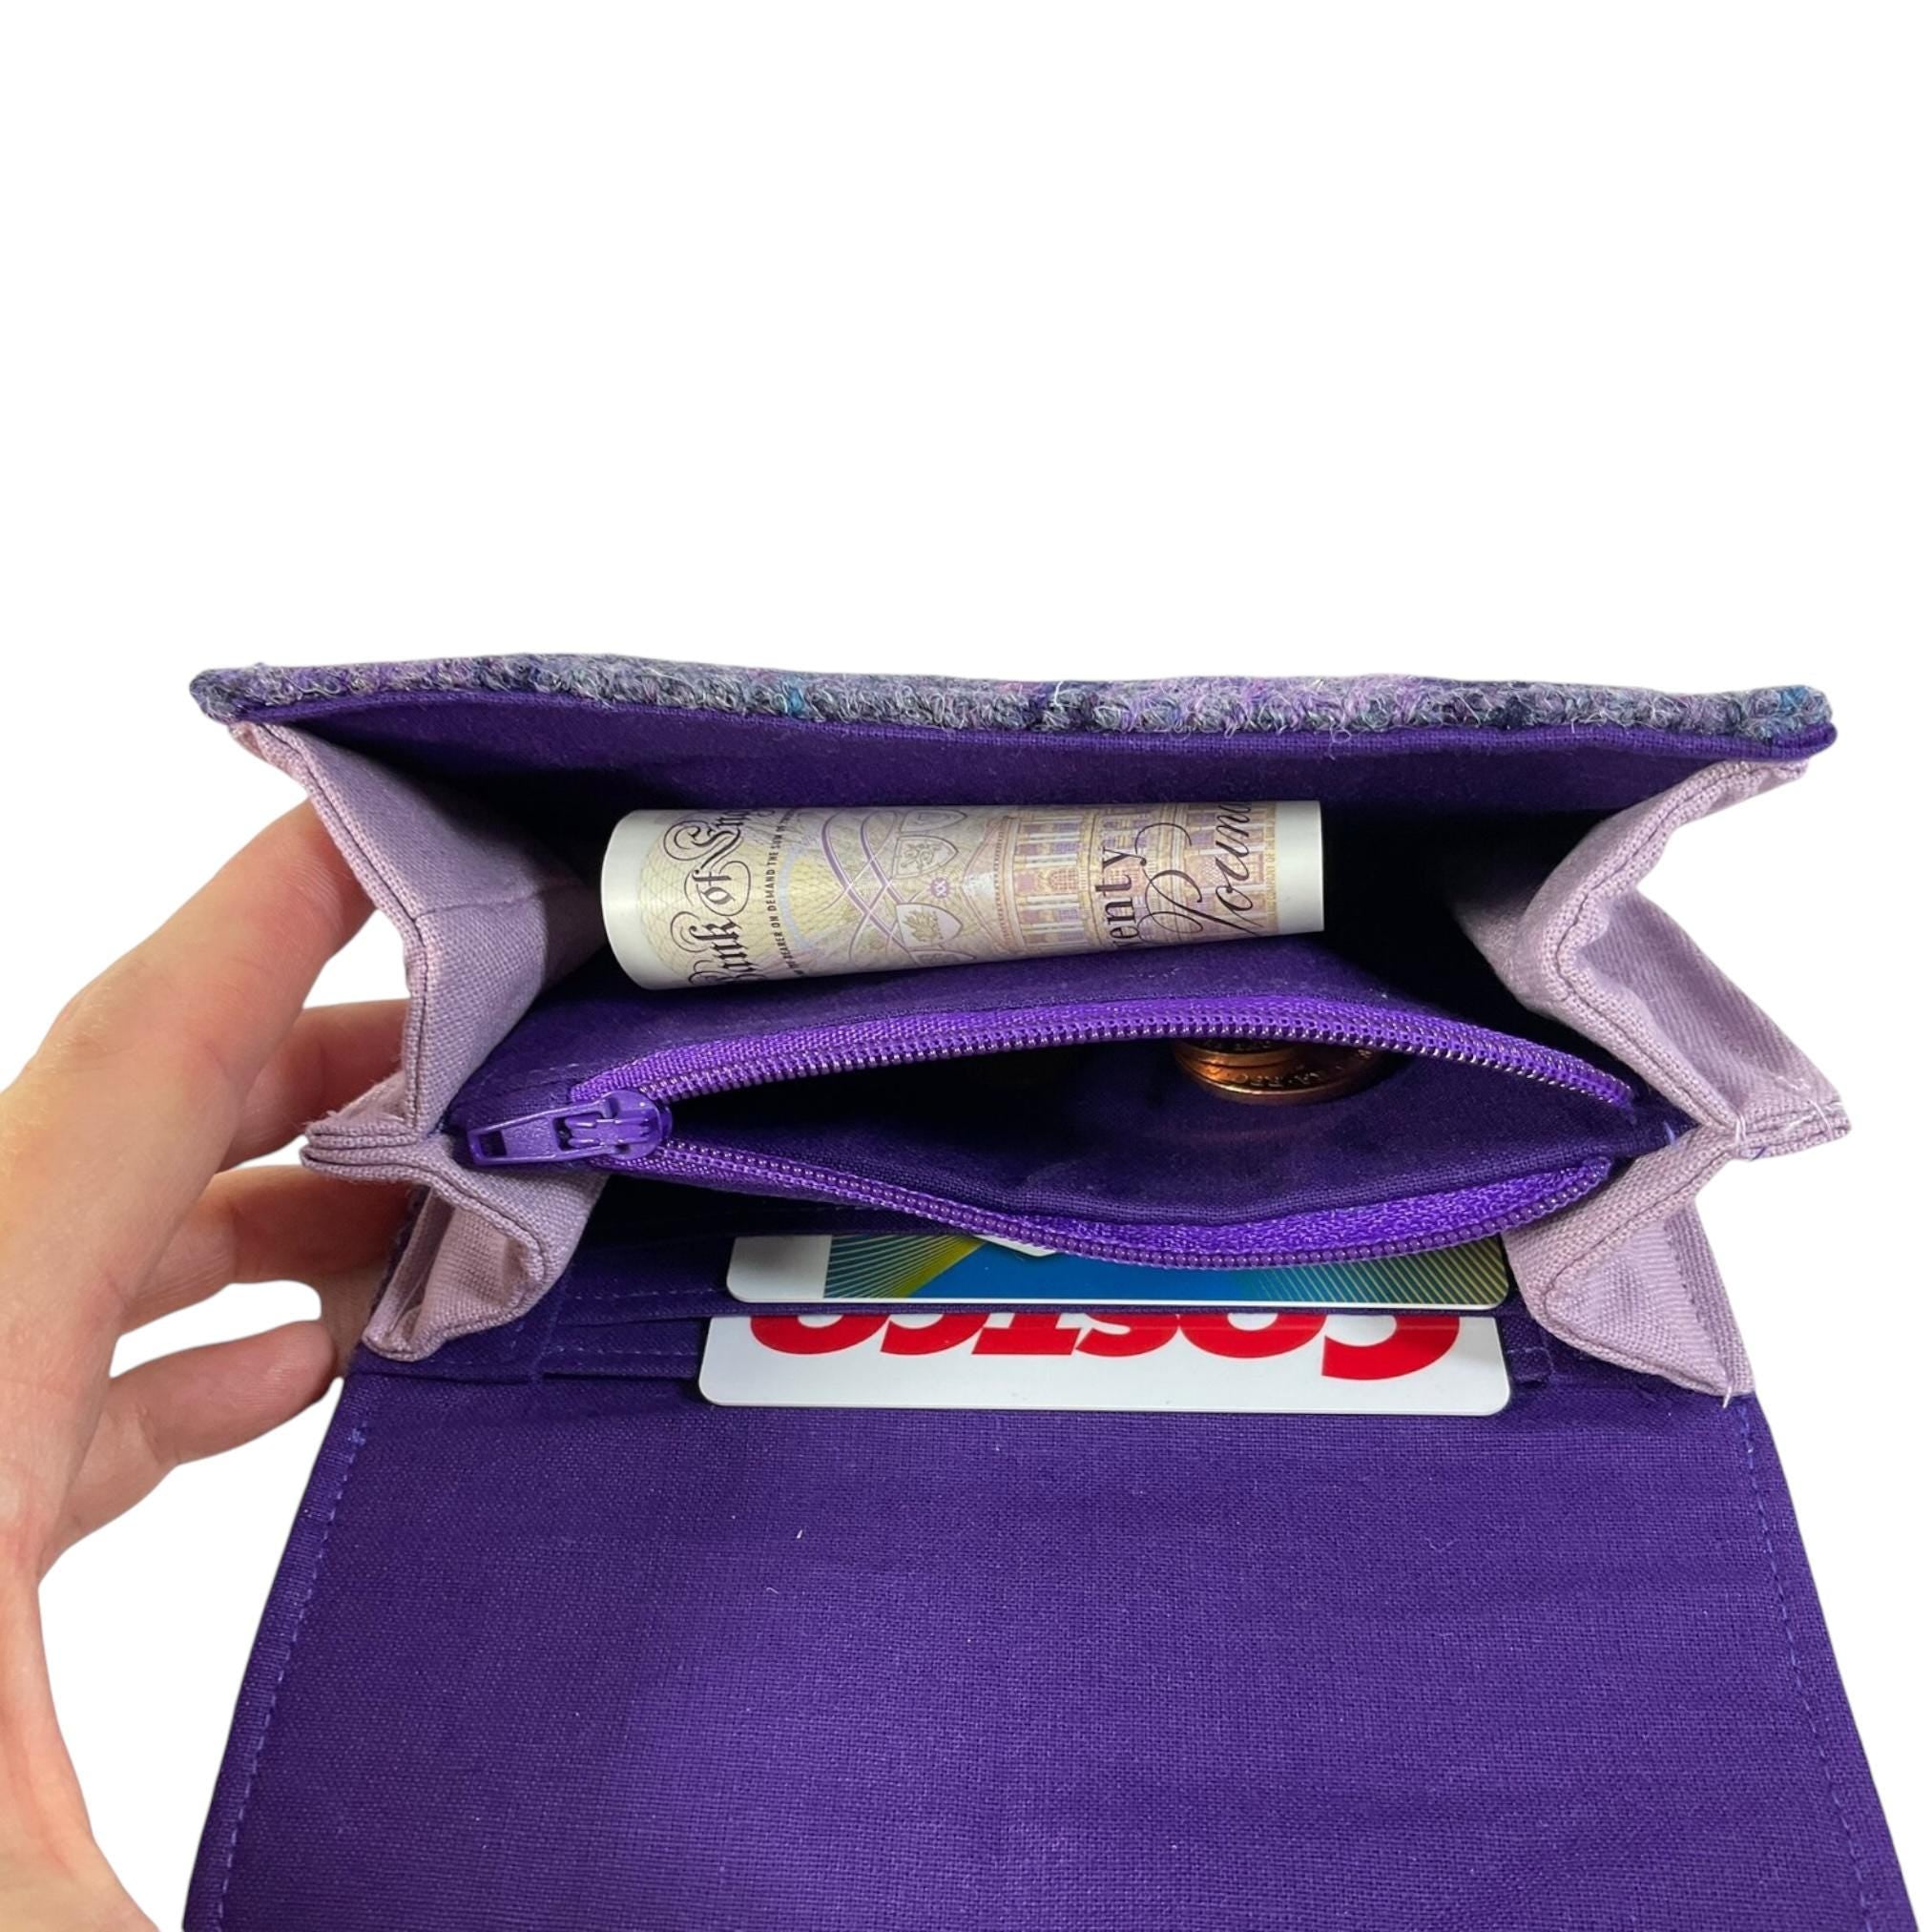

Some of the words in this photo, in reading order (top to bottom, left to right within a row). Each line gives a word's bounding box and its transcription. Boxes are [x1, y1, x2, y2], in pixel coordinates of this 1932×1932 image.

[766, 851, 779, 866] THE
[684, 861, 751, 916] of
[765, 868, 778, 912] DEMAND
[768, 915, 780, 928] ON
[773, 931, 793, 960] BEARER
